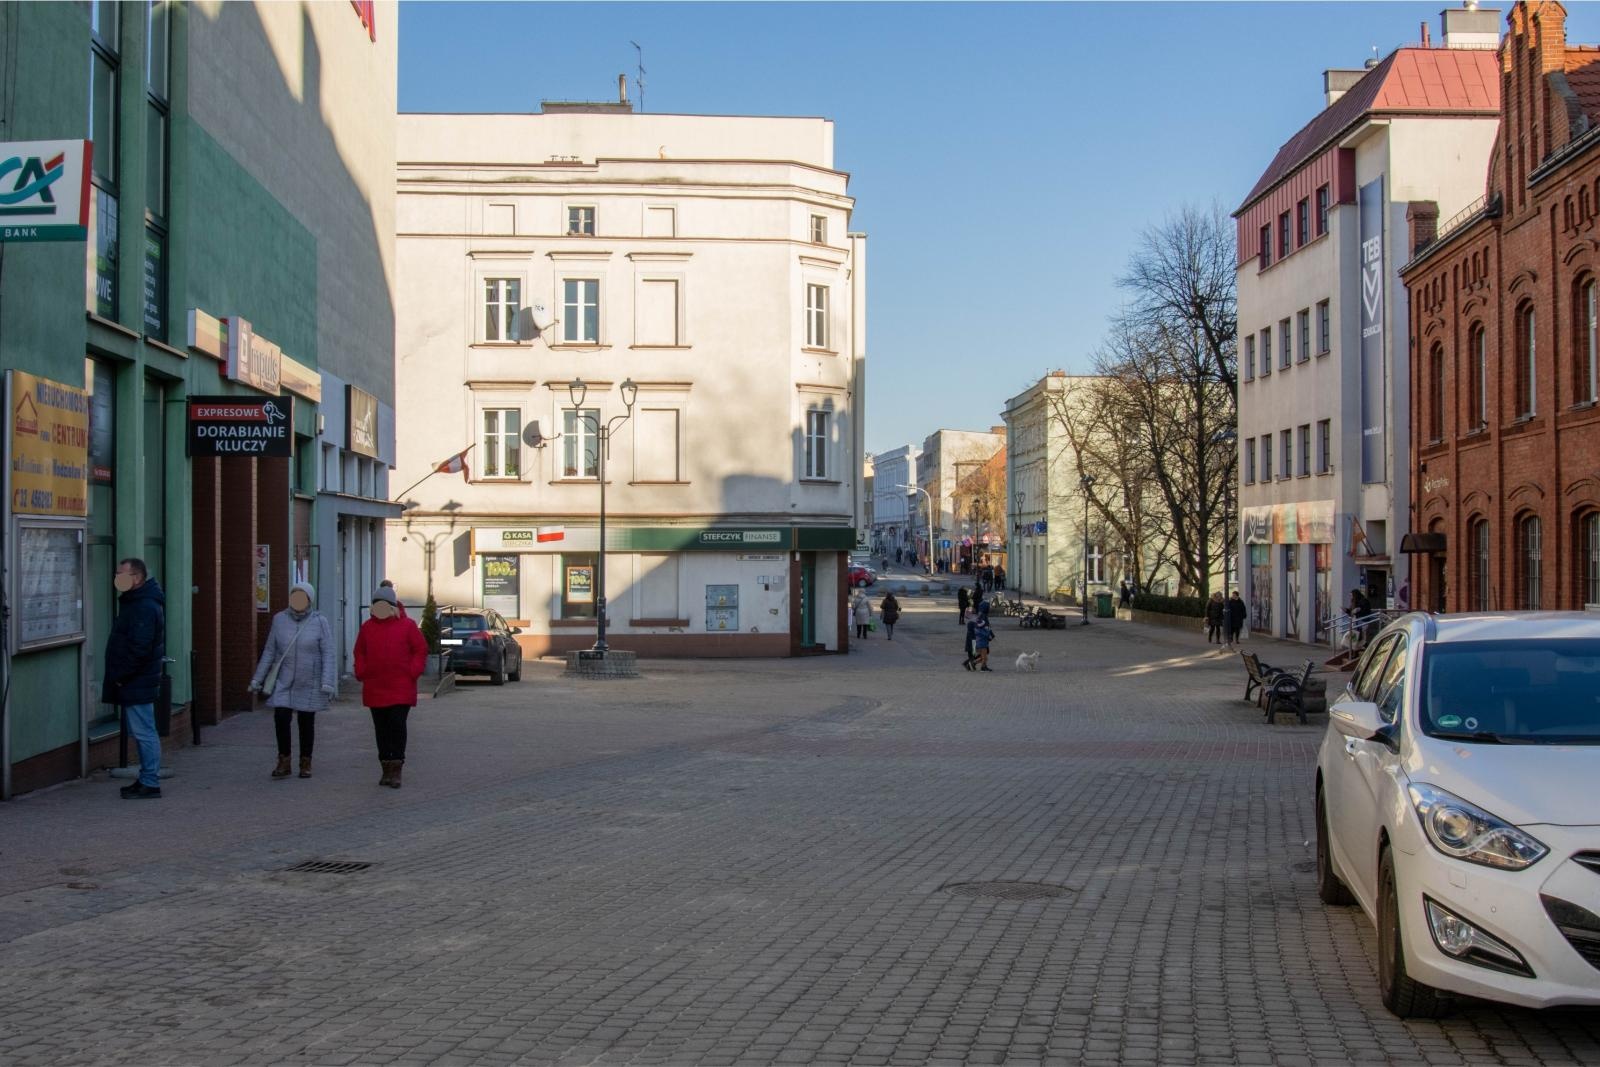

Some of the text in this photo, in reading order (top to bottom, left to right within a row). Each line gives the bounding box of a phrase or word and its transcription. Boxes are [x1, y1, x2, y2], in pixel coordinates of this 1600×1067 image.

[5, 228, 37, 237] BANK
[1363, 236, 1380, 264] TEB
[197, 408, 260, 417] EXPRESOWE
[197, 426, 285, 438] DORABIANIE
[215, 440, 268, 451] KLUCZY
